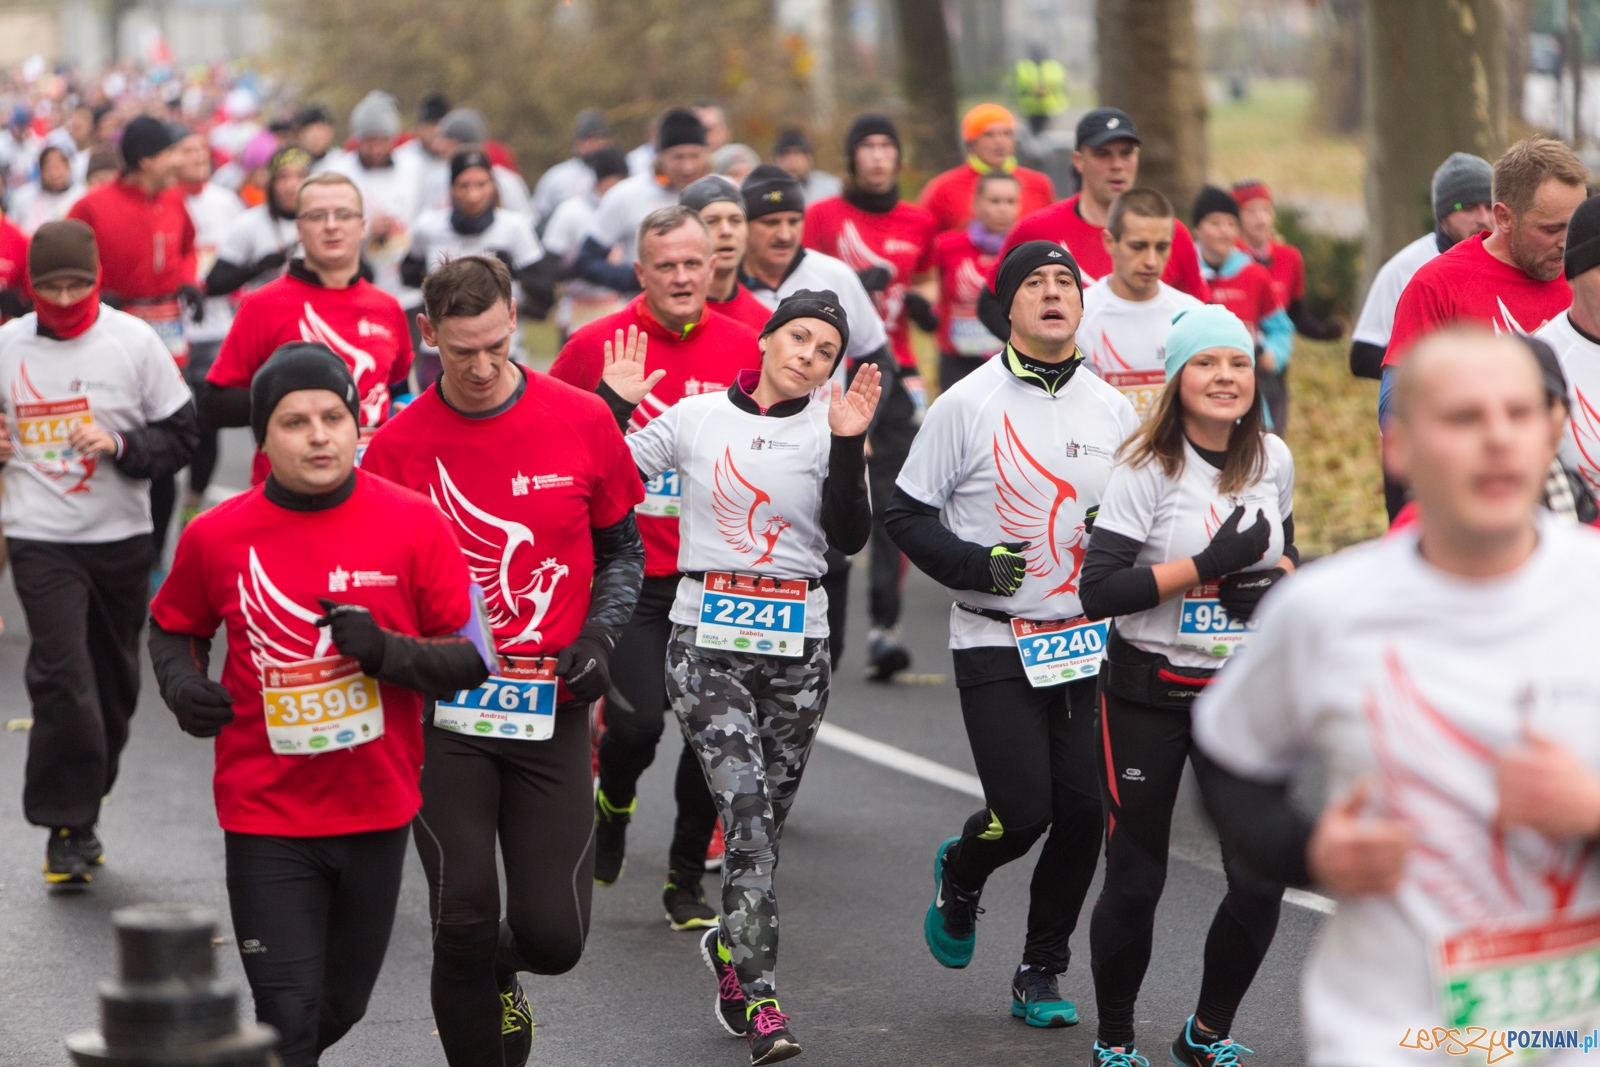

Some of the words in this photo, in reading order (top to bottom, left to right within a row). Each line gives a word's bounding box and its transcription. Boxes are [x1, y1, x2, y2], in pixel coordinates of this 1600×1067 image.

[761, 587, 800, 596] RunPoland.org
[704, 603, 713, 613] E
[714, 599, 792, 629] 2241
[1184, 612, 1193, 623] E
[739, 629, 764, 637] Izabela
[1023, 648, 1032, 657] E
[1032, 629, 1102, 662] 2240
[1046, 662, 1069, 670] Tomasz
[1069, 656, 1098, 667] Szczepan
[503, 666, 549, 676] RunPoland.org
[278, 681, 368, 724] 3596
[479, 712, 508, 721] Andrzej
[312, 723, 340, 733] Marcin
